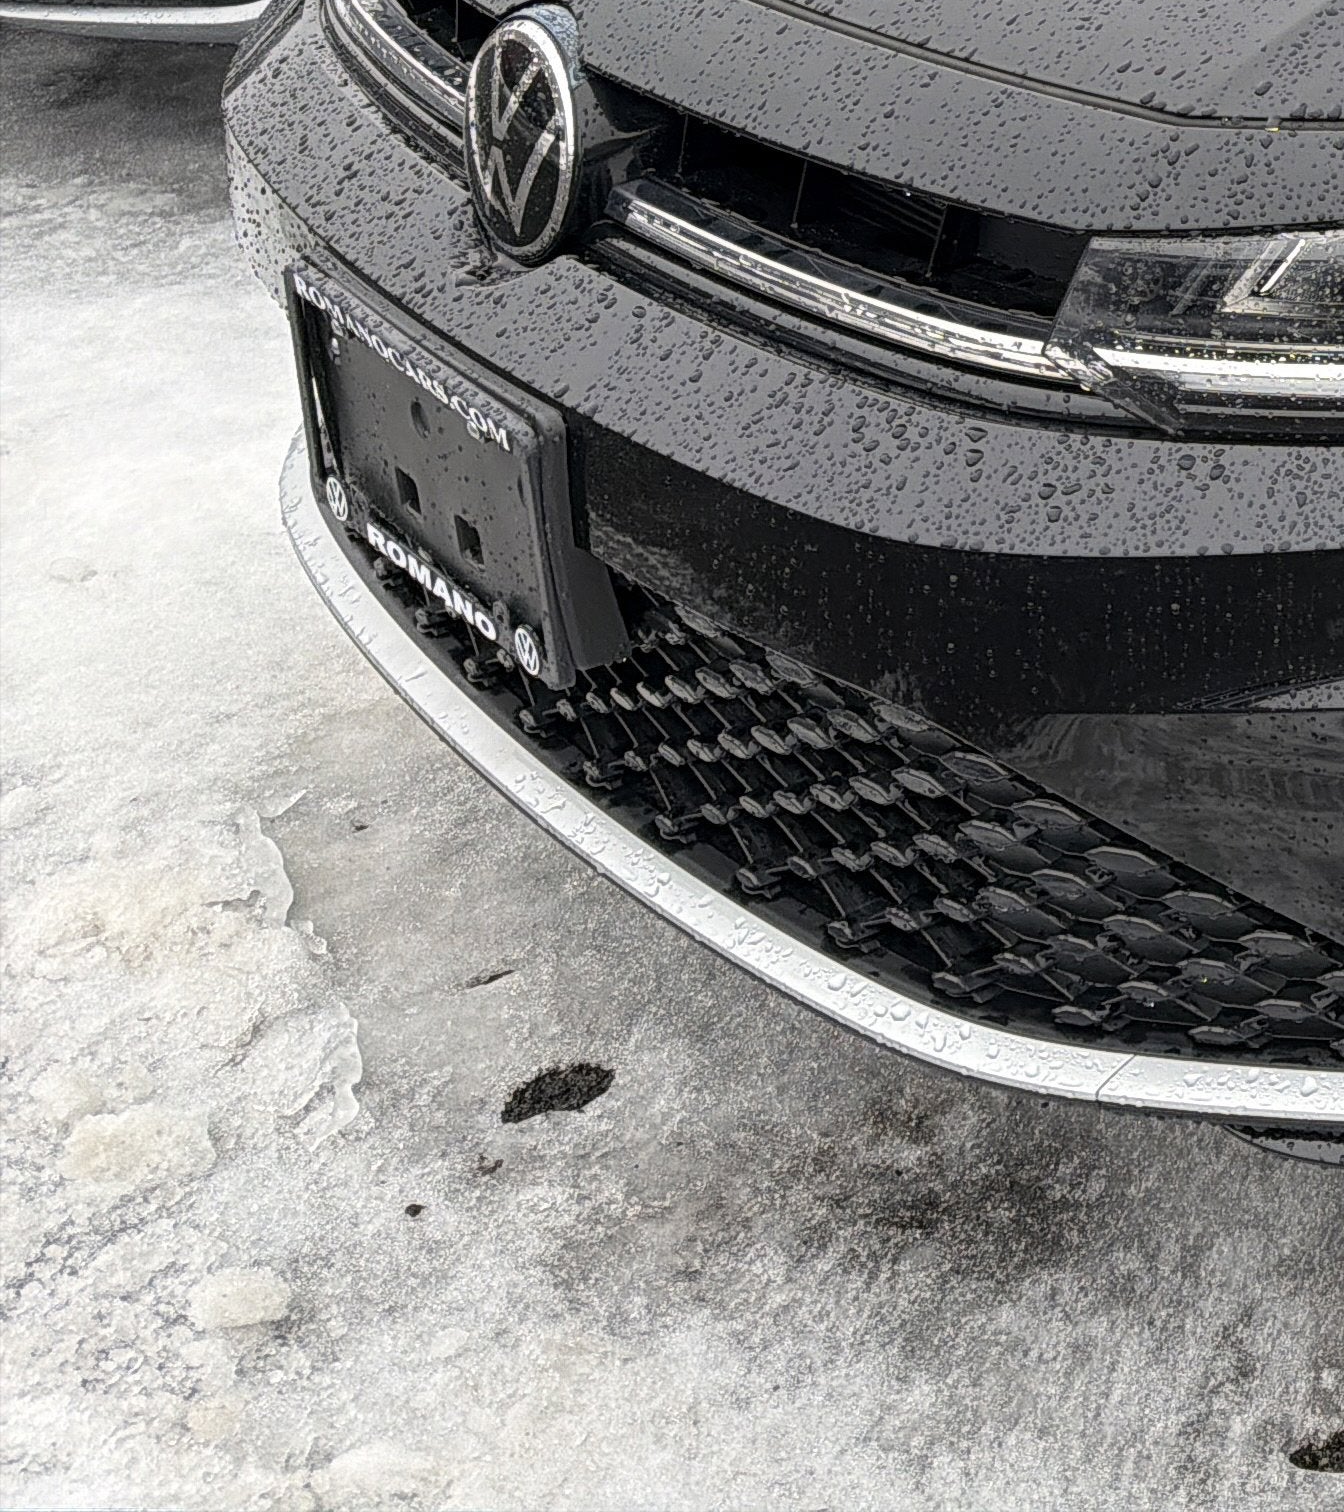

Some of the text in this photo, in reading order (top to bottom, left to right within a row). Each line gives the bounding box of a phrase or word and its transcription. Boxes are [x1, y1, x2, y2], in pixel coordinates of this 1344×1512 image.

[464, 17, 577, 260] VW
[293, 273, 511, 452] ROMANOCARS.COM
[366, 522, 497, 640] ROMANO
[514, 627, 539, 675] VW
